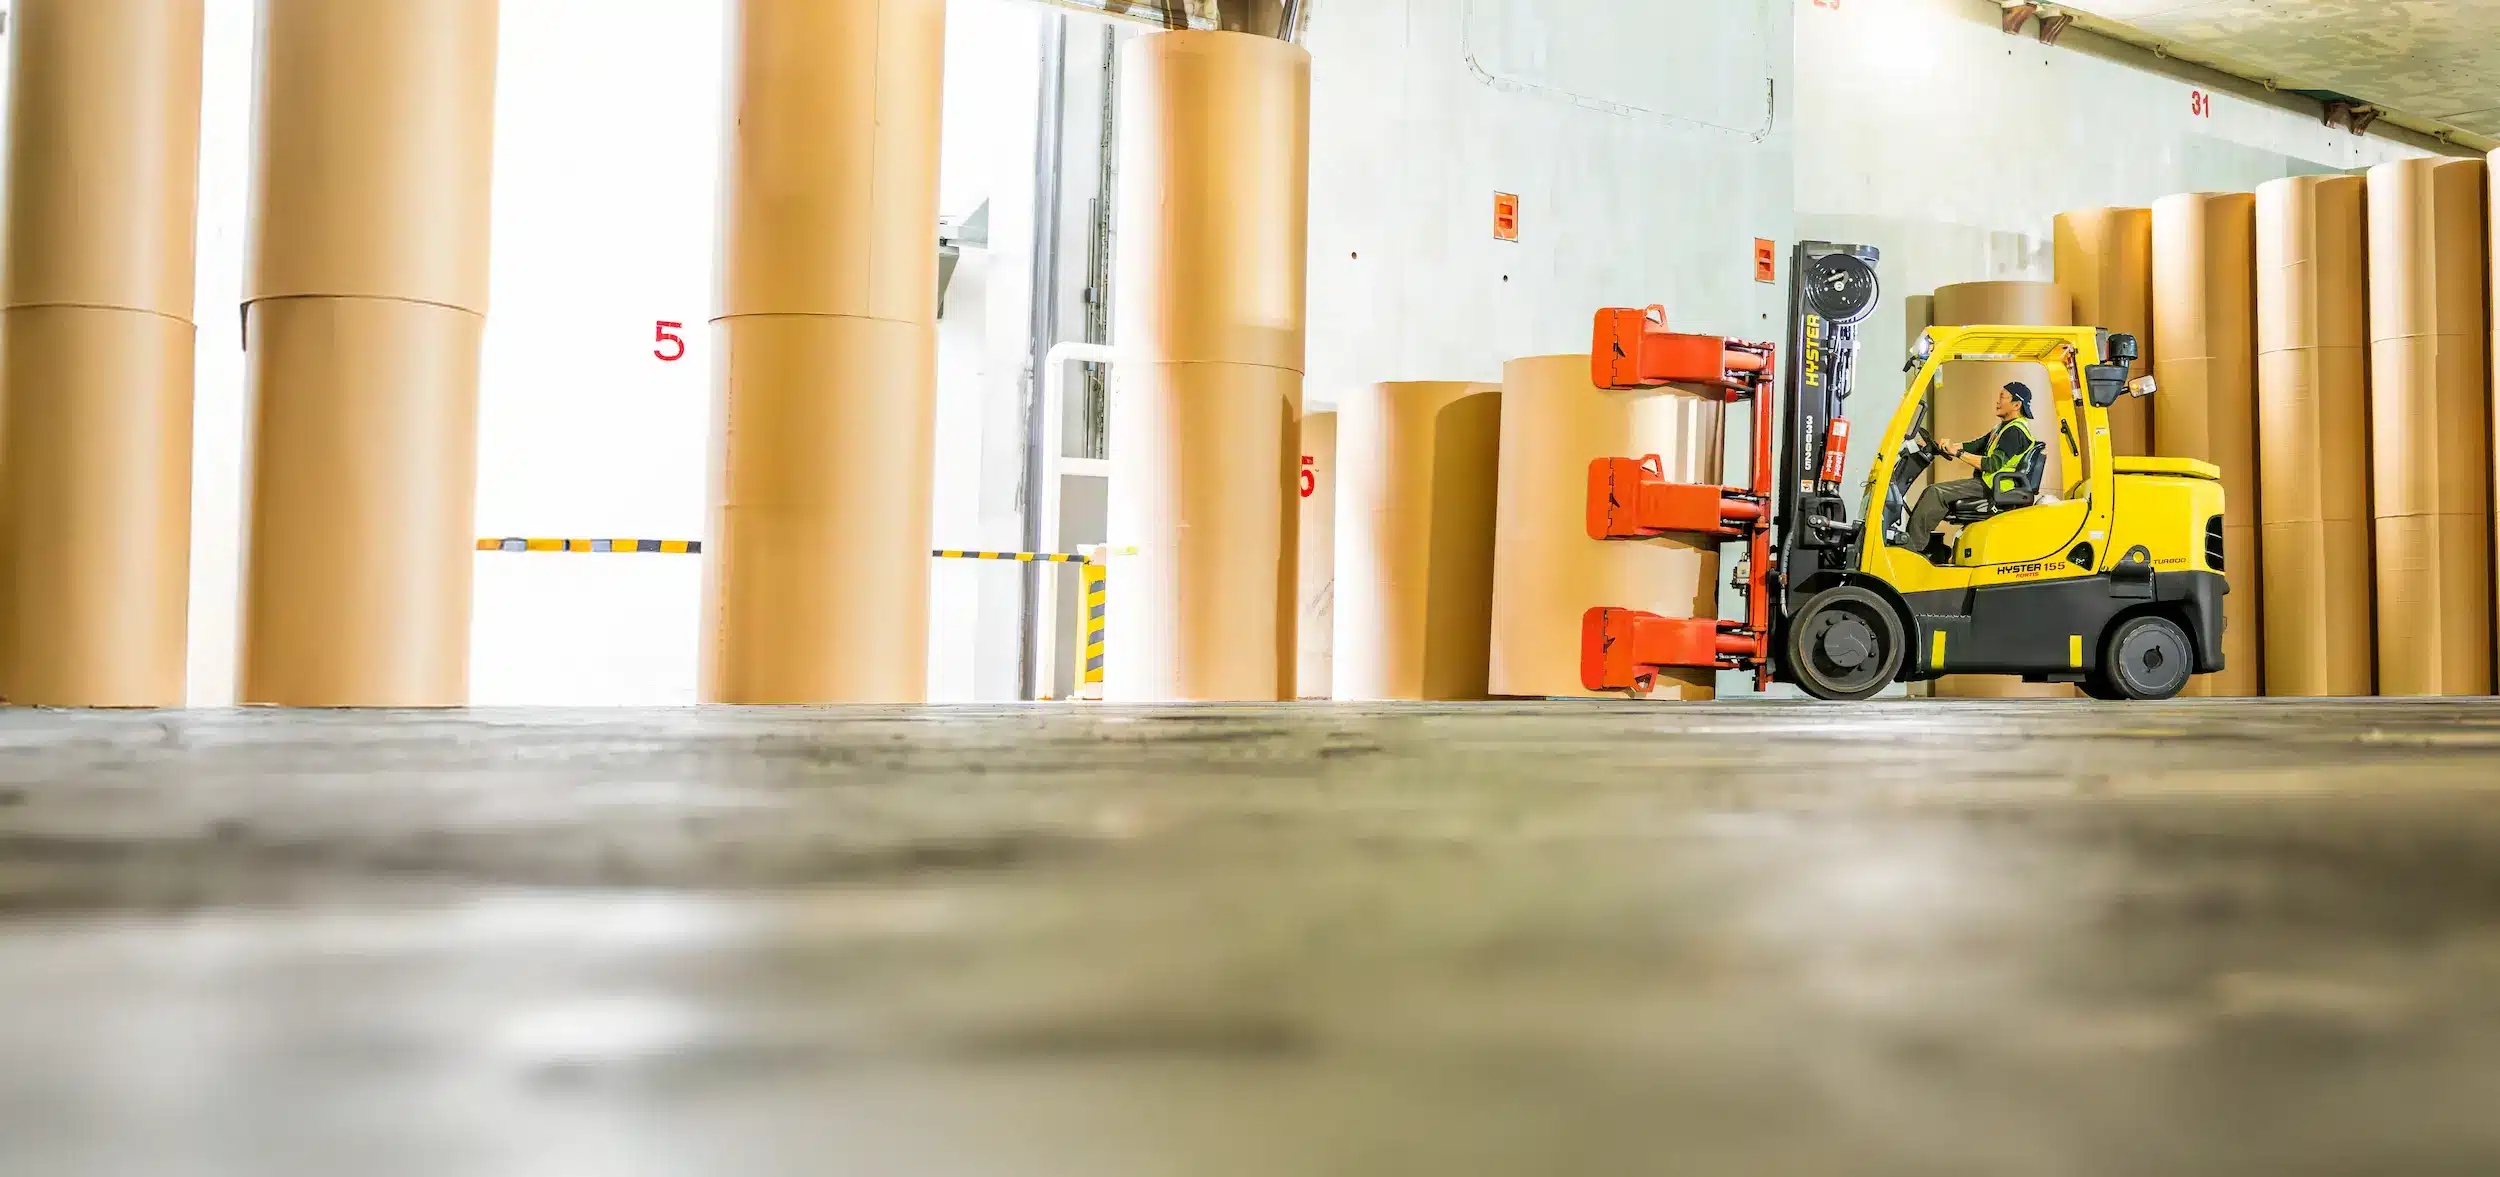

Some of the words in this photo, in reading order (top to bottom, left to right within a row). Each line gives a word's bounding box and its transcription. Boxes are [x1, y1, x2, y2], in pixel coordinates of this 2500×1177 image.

[2191, 90, 2209, 119] 31
[654, 321, 684, 361] 5
[1805, 314, 1820, 387] HYSTER
[1997, 563, 2042, 575] HYSTER
[2043, 561, 2066, 572] 155
